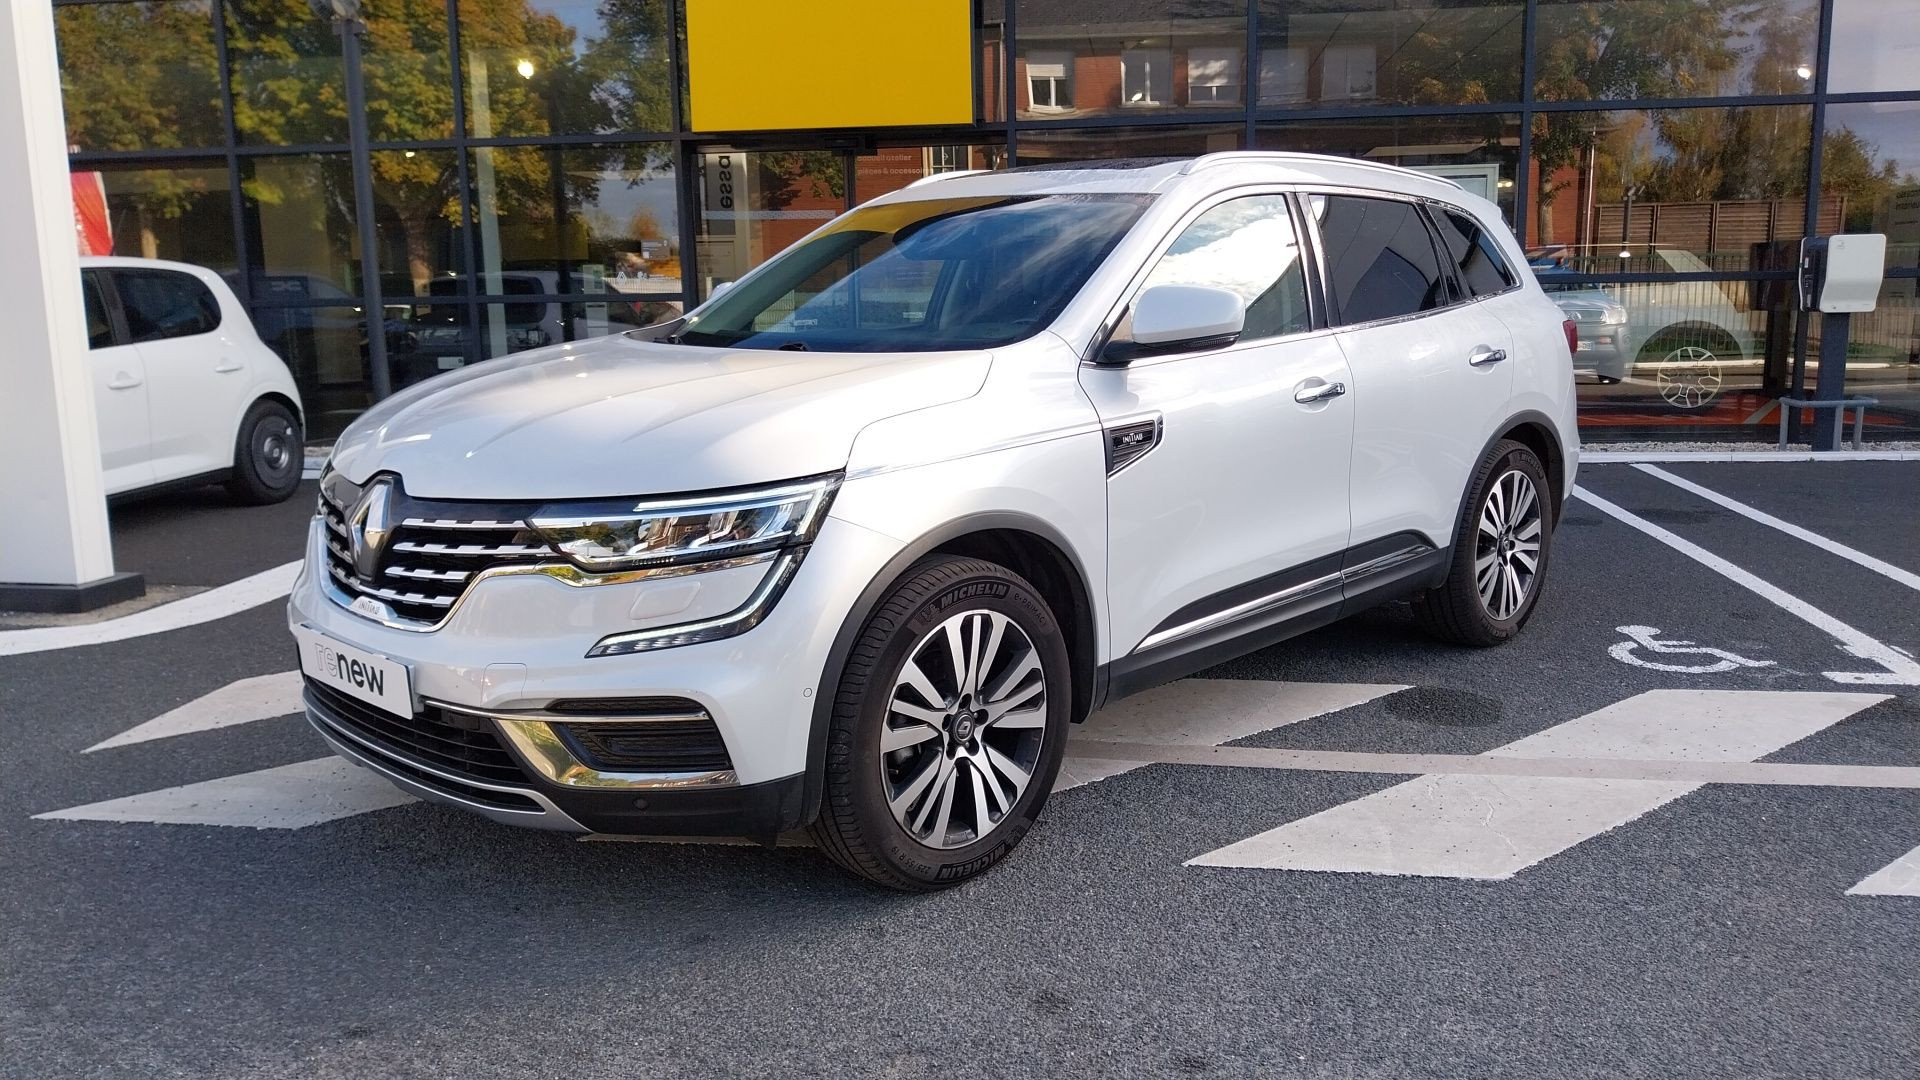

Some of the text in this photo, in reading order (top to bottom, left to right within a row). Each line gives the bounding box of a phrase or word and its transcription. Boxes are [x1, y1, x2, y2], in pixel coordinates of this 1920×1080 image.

[941, 583, 1008, 608] MICHELIN
[314, 642, 384, 696] renew
[939, 844, 1005, 879] MICHELIN
